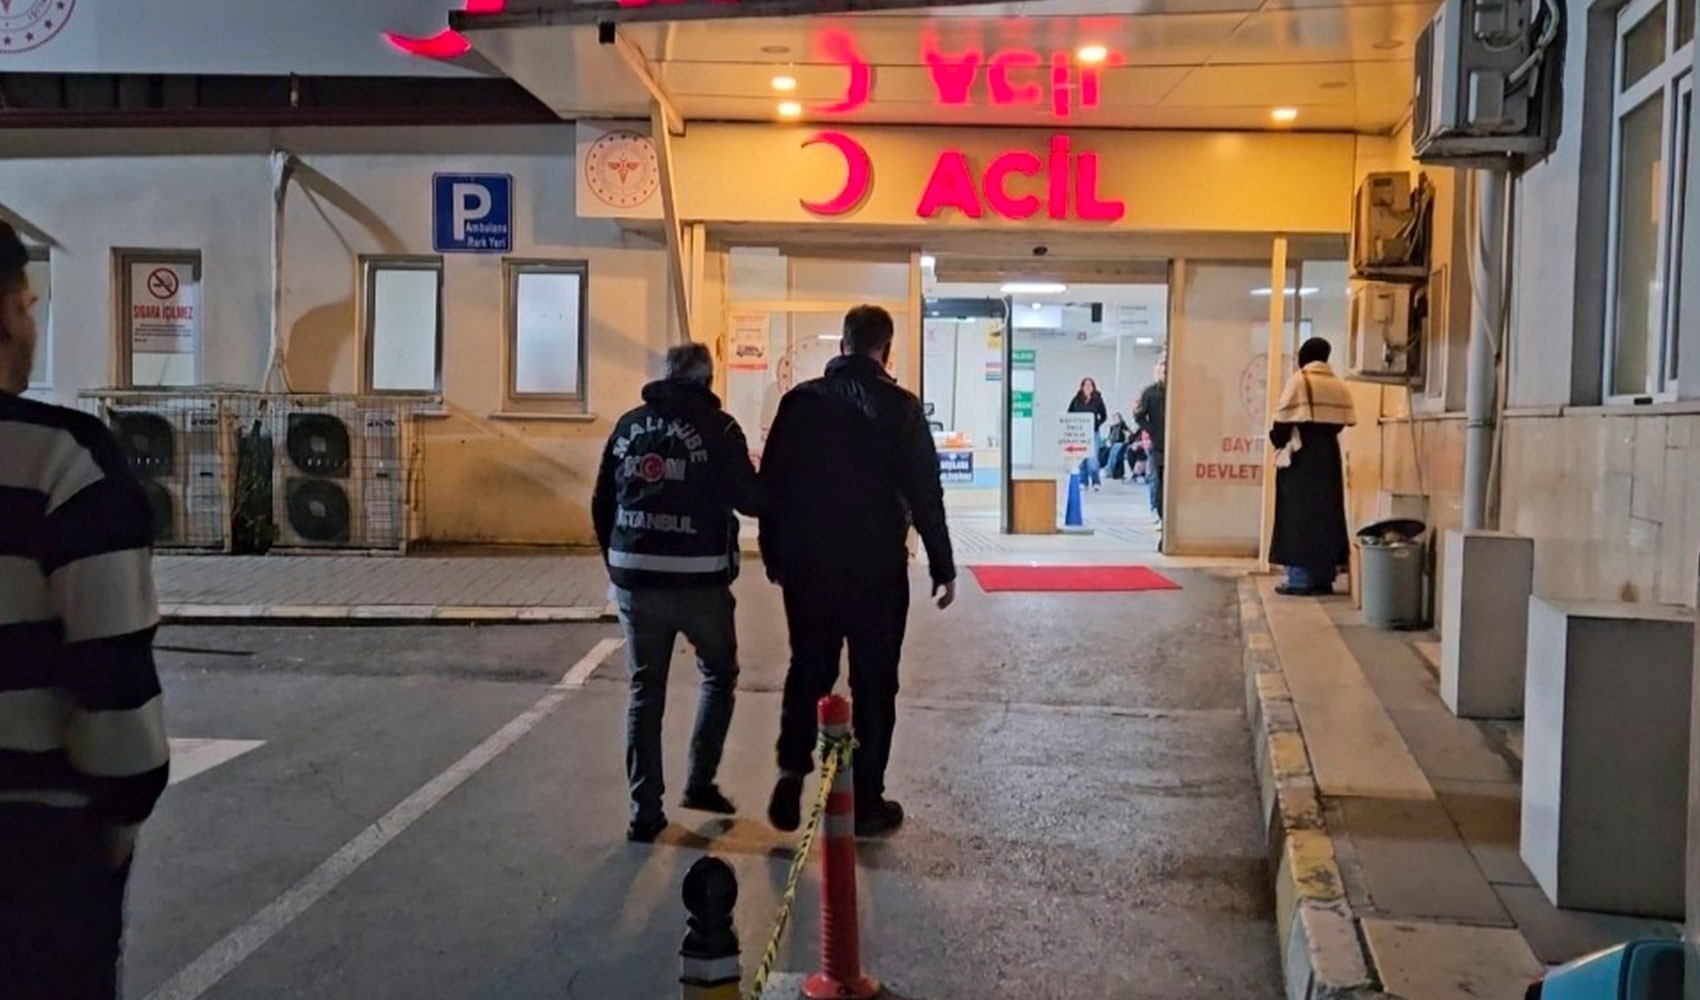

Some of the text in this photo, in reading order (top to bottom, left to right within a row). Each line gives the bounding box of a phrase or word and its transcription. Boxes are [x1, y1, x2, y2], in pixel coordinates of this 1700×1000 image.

[916, 135, 1125, 221] ACİL
[453, 183, 491, 240] P
[466, 221, 508, 233] Ambulans
[467, 236, 506, 248] Park Yeri
[1196, 463, 1261, 480] DEVLET
